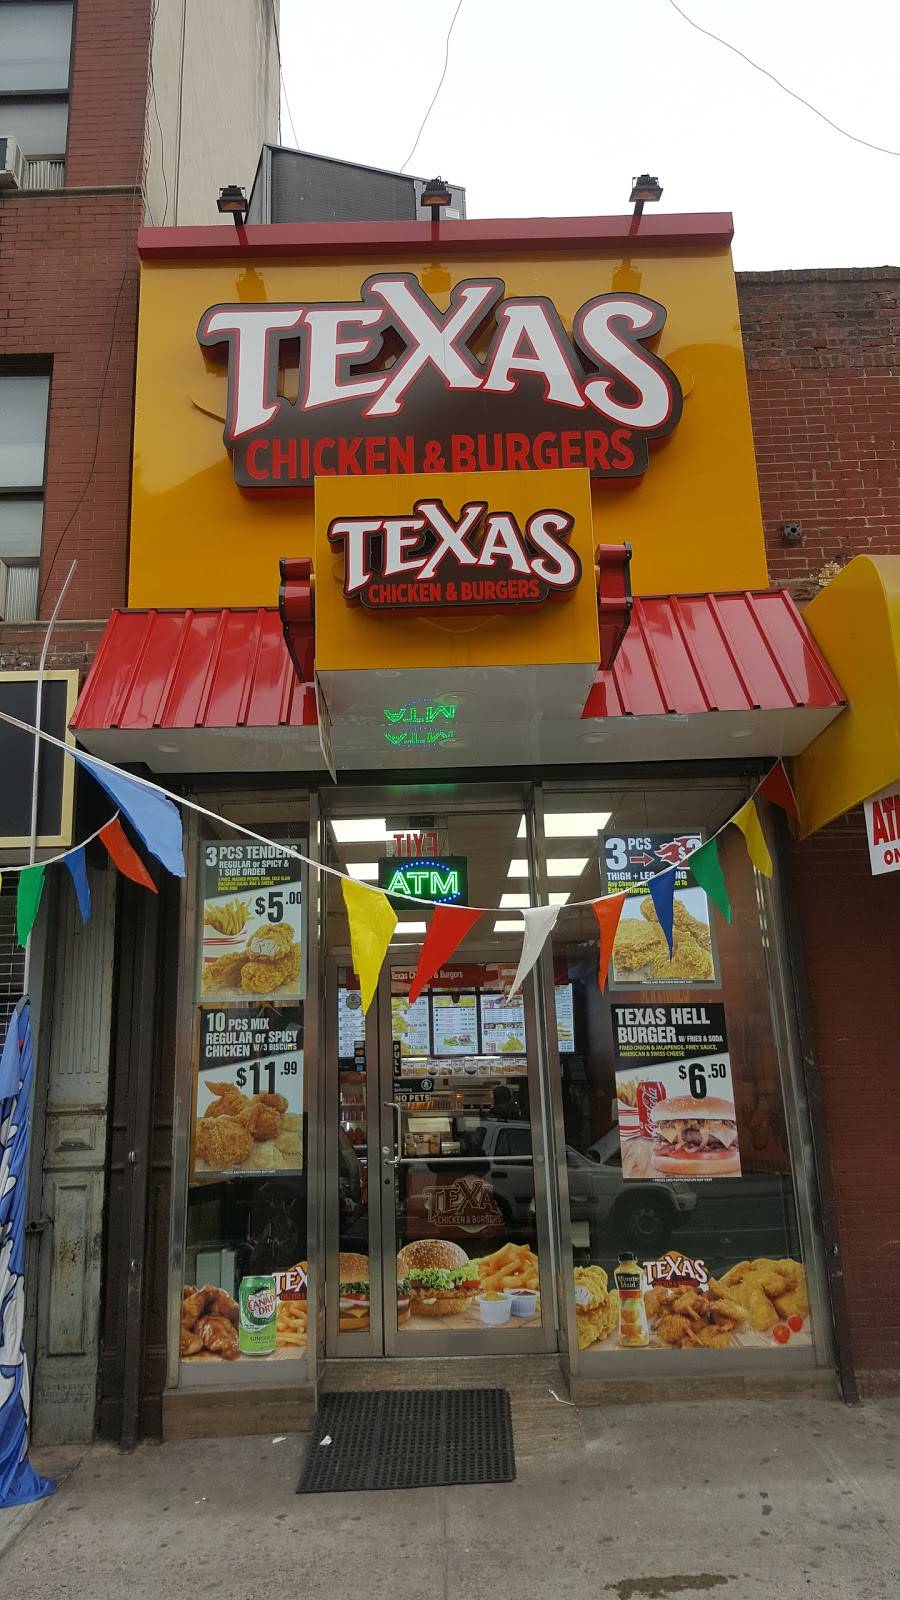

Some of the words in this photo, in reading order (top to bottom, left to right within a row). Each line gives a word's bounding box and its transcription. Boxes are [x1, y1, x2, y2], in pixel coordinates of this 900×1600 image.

[206, 280, 670, 437] TEXAS
[247, 435, 415, 480] CHICKEN
[423, 443, 446, 473] &
[452, 430, 634, 474] BURGERS
[332, 504, 576, 591] TEXAS
[368, 583, 441, 603] CHICKEN
[445, 582, 457, 601] &
[461, 579, 541, 601] BURGERS
[873, 795, 900, 846] AT
[206, 846, 218, 867] 3
[219, 846, 243, 859] PCS
[246, 845, 298, 859] TENDERS
[261, 860, 283, 868] SPICY
[604, 838, 628, 870] 3
[628, 838, 652, 850] PCS
[224, 868, 241, 876] SIDE
[242, 868, 266, 876] ORDER
[388, 870, 458, 894] ATM
[606, 872, 632, 881] THIGH
[206, 1012, 226, 1031] 10
[228, 1018, 248, 1030] PCS
[250, 1018, 269, 1030] MIX
[615, 1008, 667, 1025] TEXAS
[670, 1007, 710, 1024] HELL
[206, 1031, 252, 1044] REGULAR
[255, 1033, 266, 1043] or
[268, 1030, 298, 1043] SPICY
[617, 1026, 676, 1043] BURGER
[205, 1044, 250, 1057] CHICKEN
[236, 1061, 297, 1095] $11.99
[678, 1062, 727, 1099] $6.50
[409, 1094, 431, 1102] PETS
[422, 1179, 501, 1222] TEXA
[643, 1255, 708, 1283] TEXAS
[248, 1294, 275, 1313] CANAD
